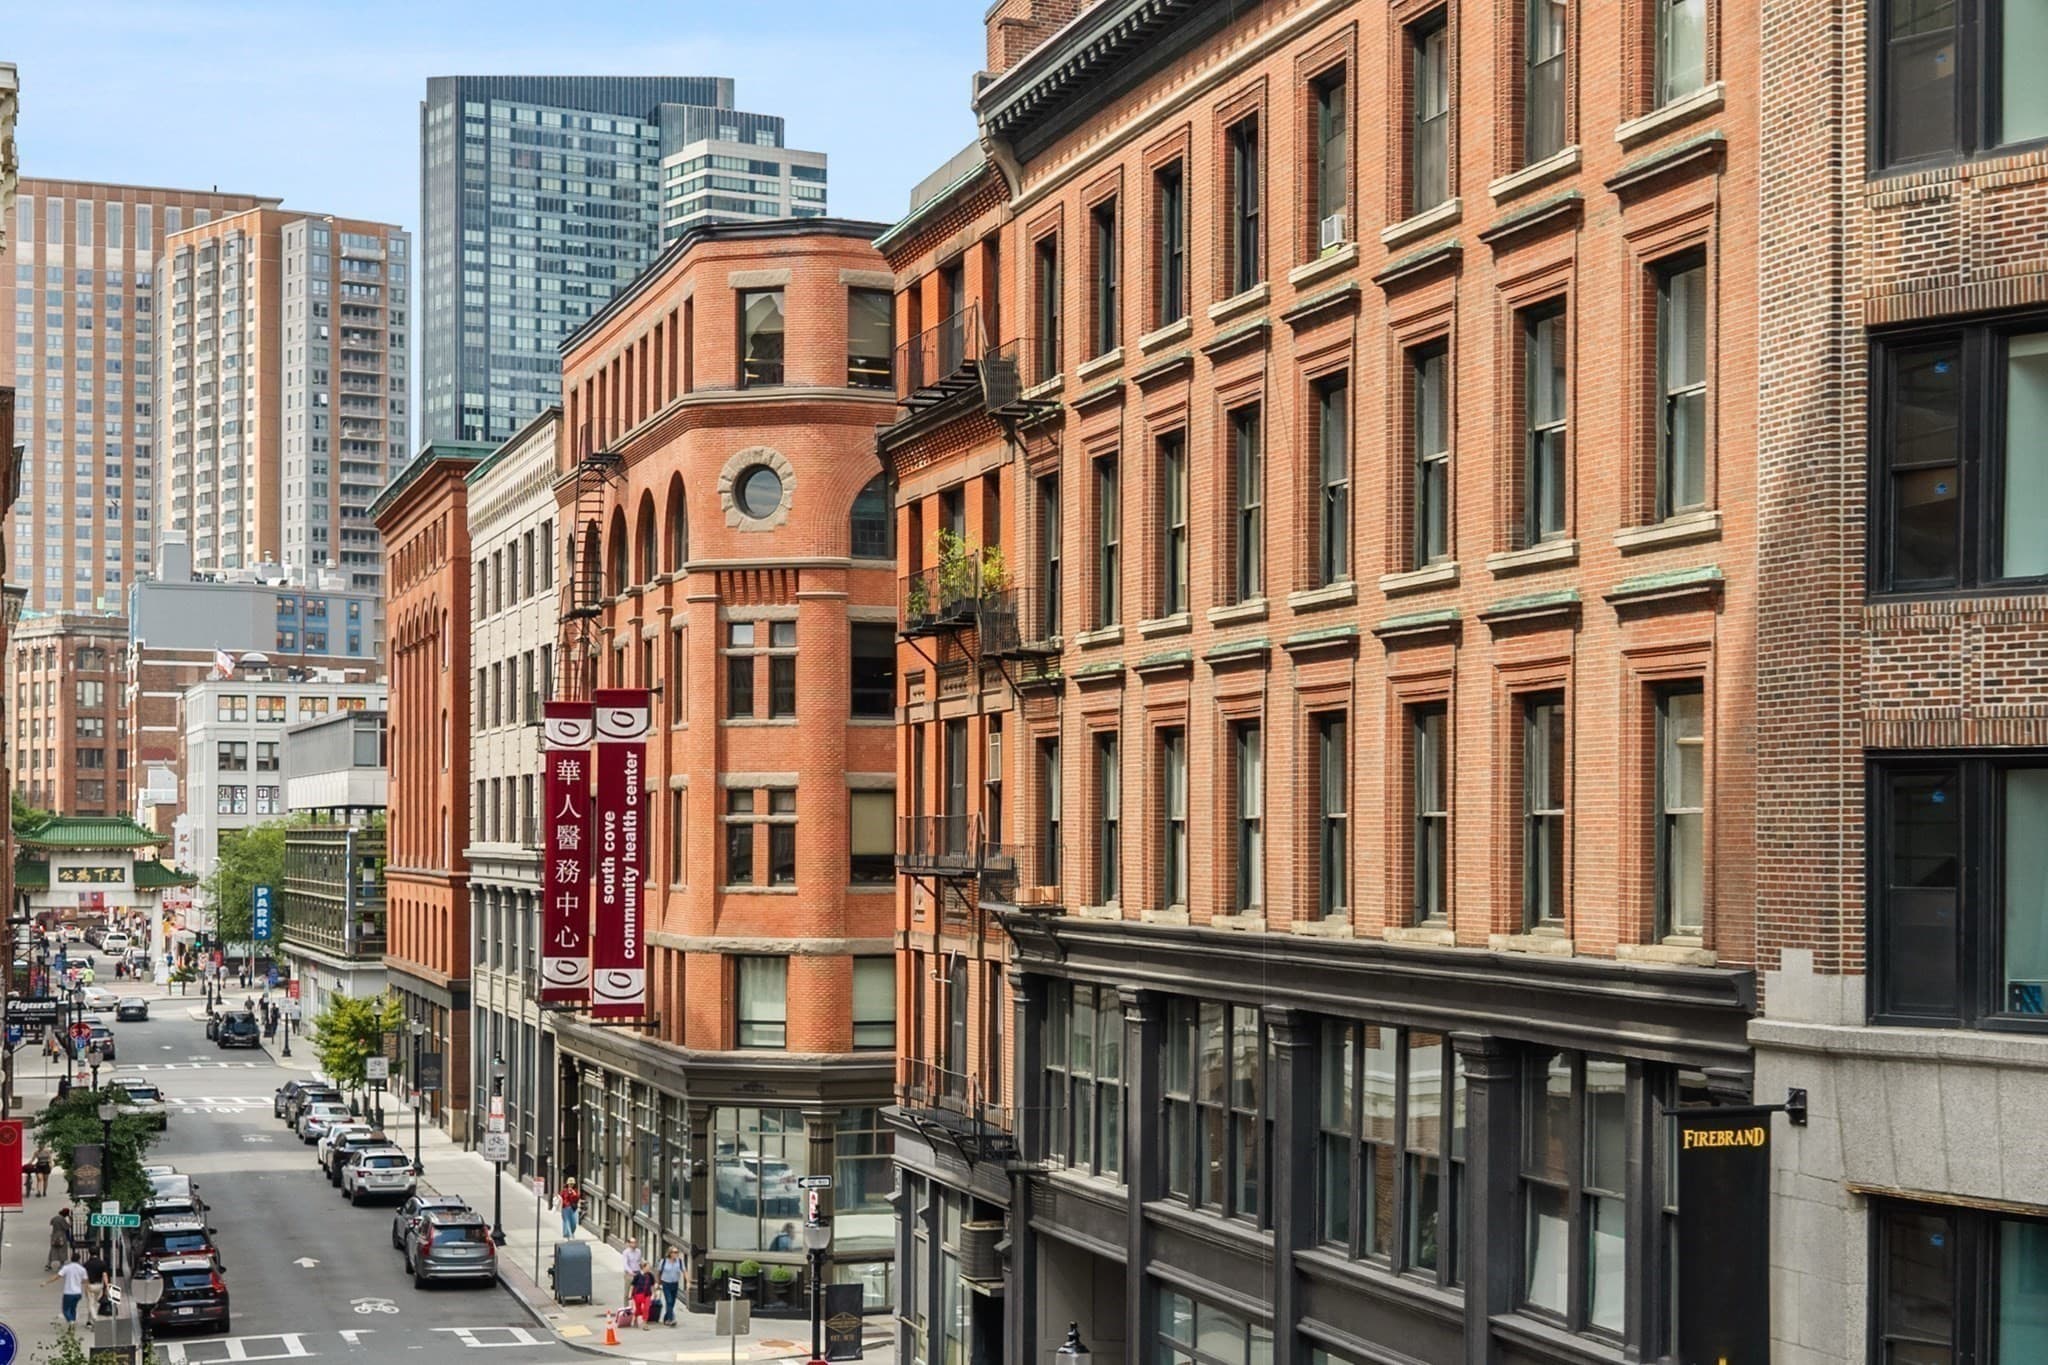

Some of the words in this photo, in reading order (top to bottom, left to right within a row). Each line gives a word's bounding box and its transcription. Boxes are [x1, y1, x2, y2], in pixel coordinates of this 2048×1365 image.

[623, 750, 639, 806] center
[555, 759, 582, 949] 華人醫務中心
[604, 810, 616, 852] cove
[621, 810, 638, 863] health
[601, 856, 616, 905] south
[256, 887, 269, 928] PARK
[621, 866, 640, 960] community
[1683, 1127, 1765, 1149] FIREBRAND
[95, 1215, 126, 1226] SOUTH
